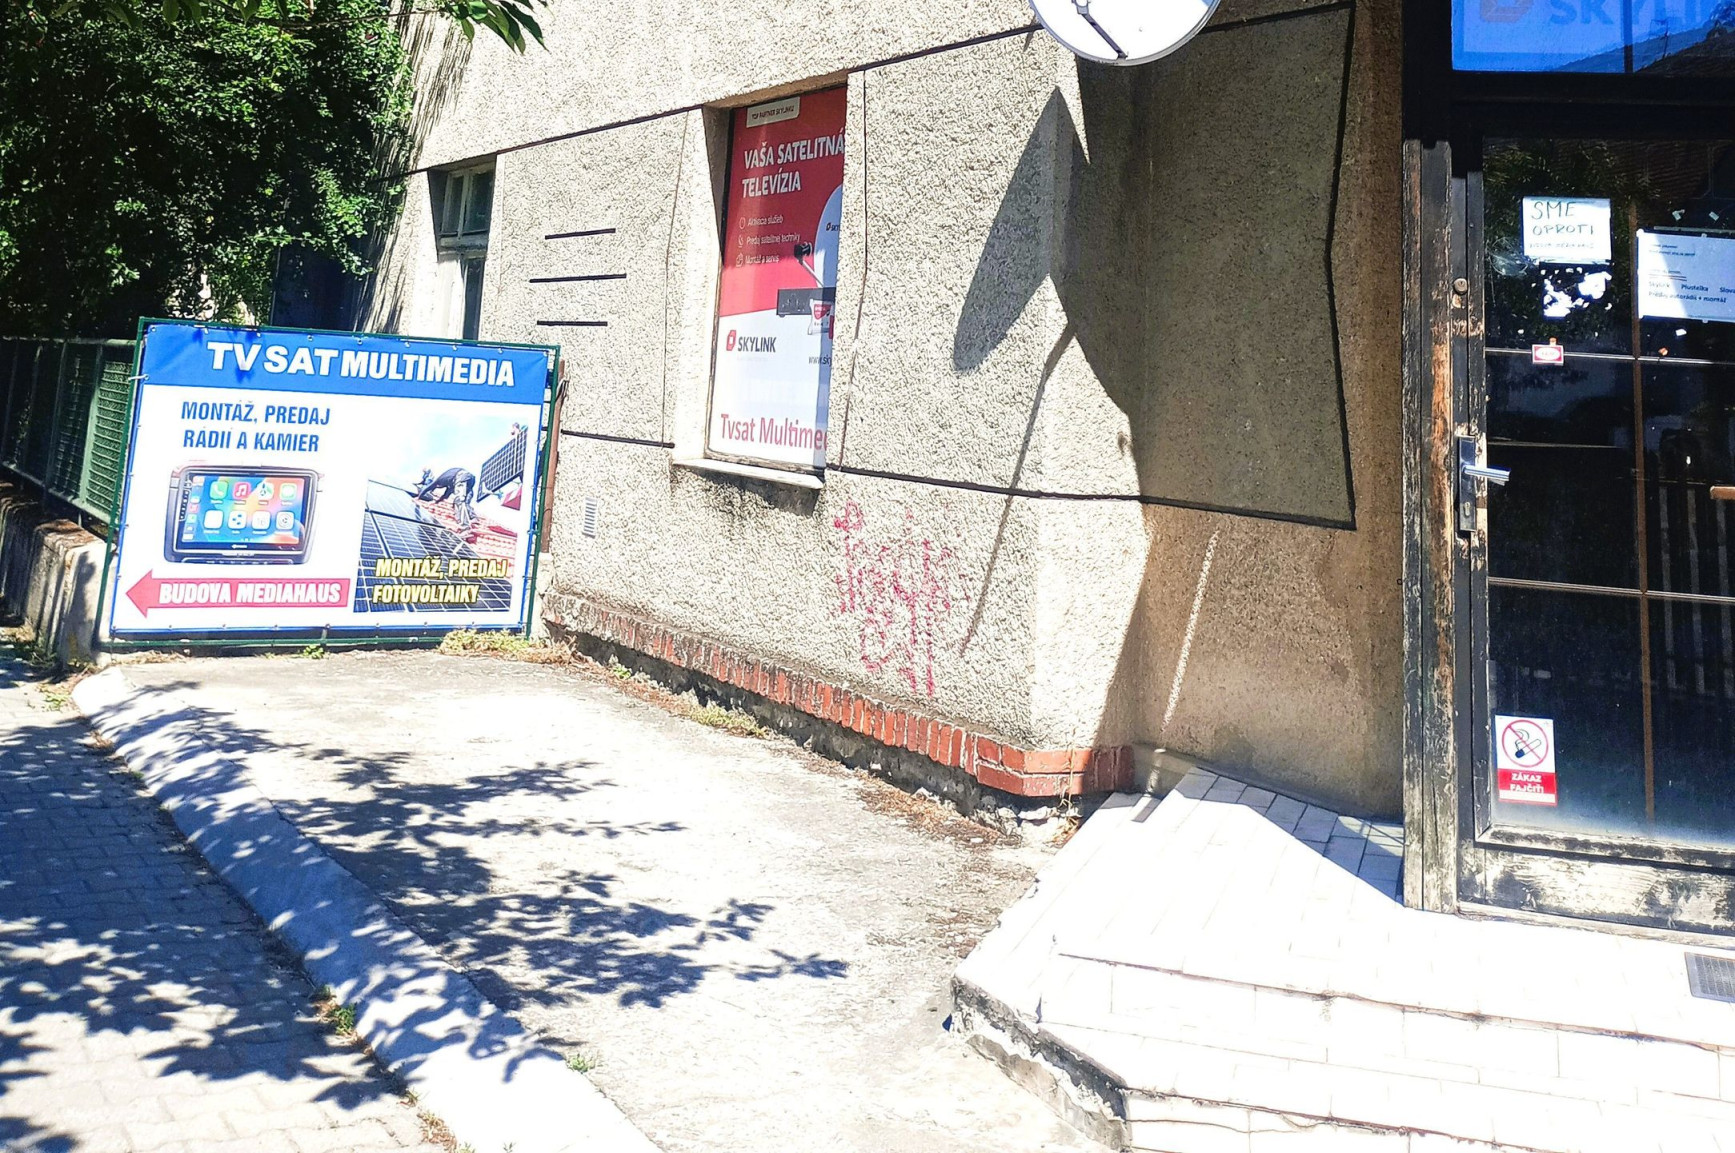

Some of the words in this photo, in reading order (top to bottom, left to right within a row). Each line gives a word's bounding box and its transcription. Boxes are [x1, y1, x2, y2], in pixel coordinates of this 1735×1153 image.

[744, 141, 774, 169] VAŠA
[777, 128, 846, 165] SATELITNÁ
[742, 168, 801, 198] TELEVÍZIA
[1531, 200, 1577, 220] SME
[1532, 223, 1594, 236] OPROTI
[738, 336, 777, 353] SKYLINK
[207, 341, 262, 371] TV
[263, 345, 339, 377] SAT
[340, 350, 515, 387] MULTIMEDIA
[181, 400, 258, 424] MONTÁŽ,
[264, 405, 331, 425] PREDAJ
[721, 413, 756, 443] Tvsat
[236, 431, 248, 450] A
[253, 432, 320, 452] KAMIER
[374, 555, 444, 579] MONTÁŽ,
[448, 559, 508, 578] PREDAJ
[158, 584, 232, 605] BUDOVA
[236, 583, 342, 604] MEDIAHAUS
[371, 584, 480, 604] FOTOVOLTAIKY
[1511, 771, 1542, 783] ZÁKAZ
